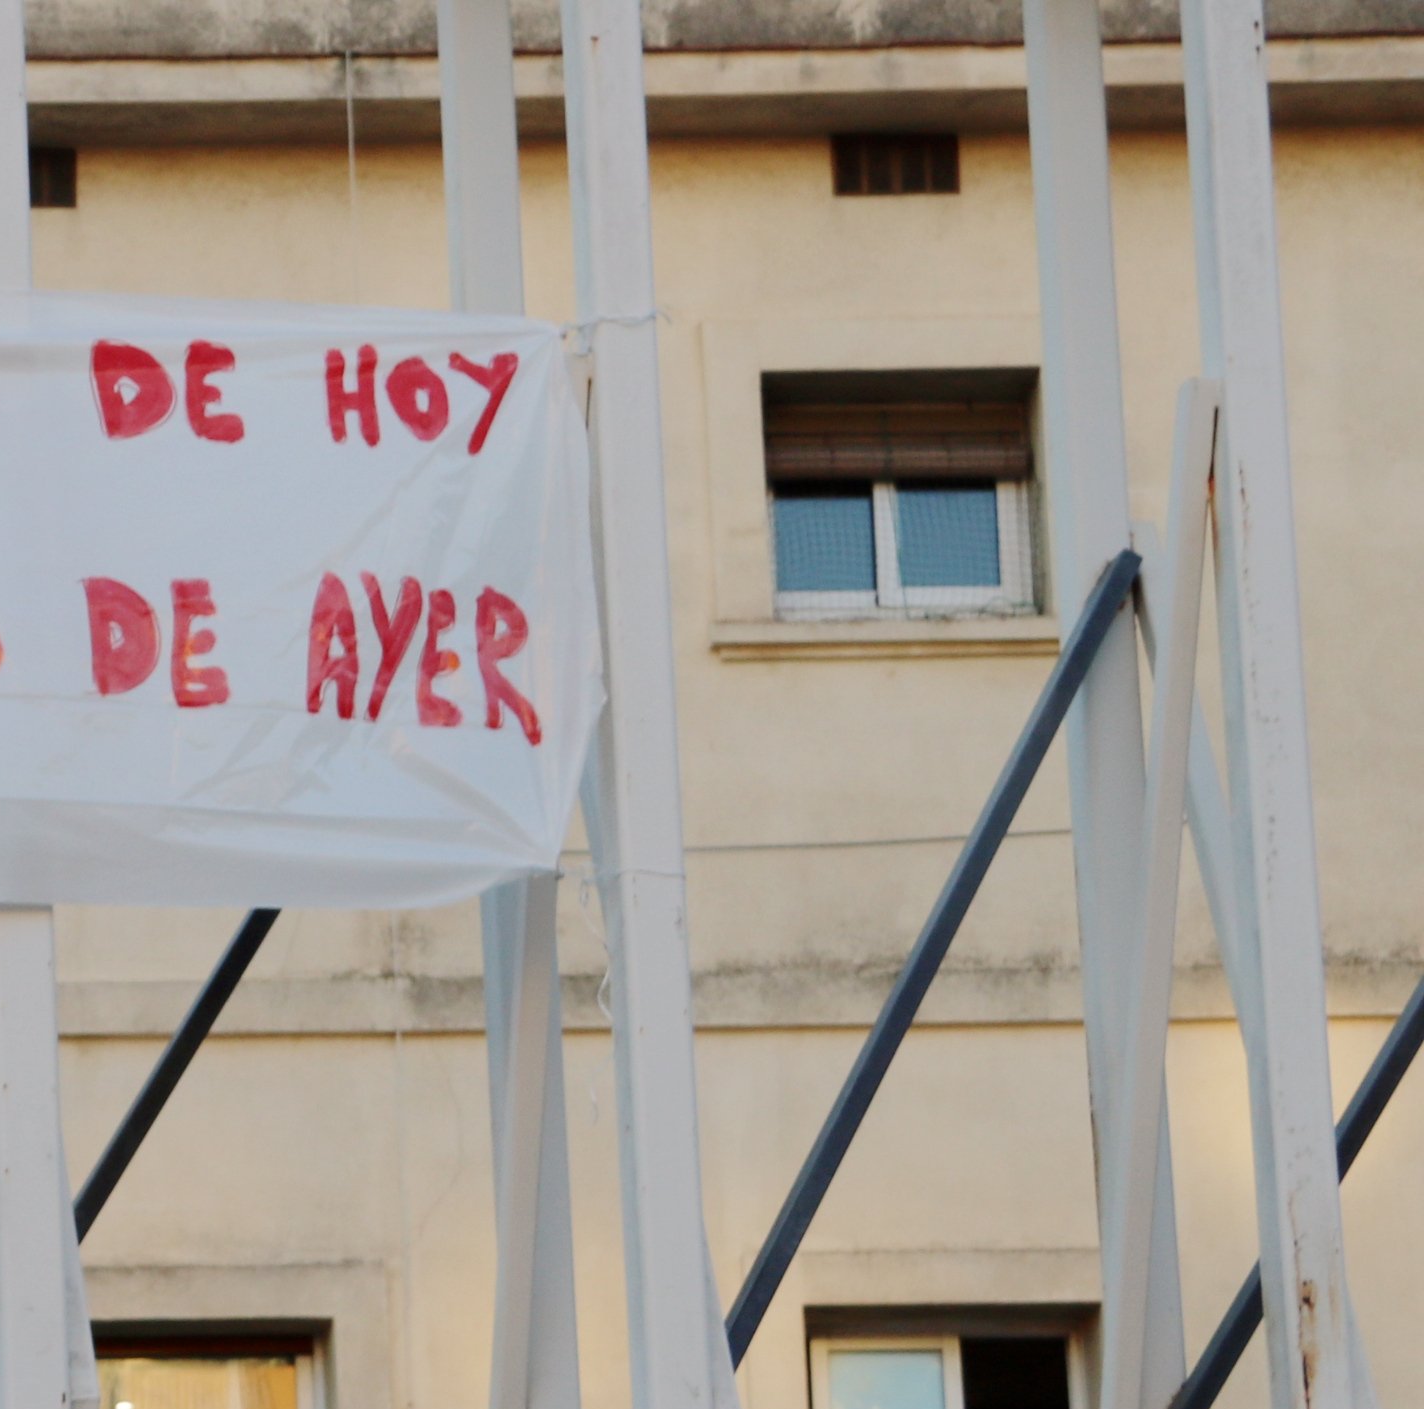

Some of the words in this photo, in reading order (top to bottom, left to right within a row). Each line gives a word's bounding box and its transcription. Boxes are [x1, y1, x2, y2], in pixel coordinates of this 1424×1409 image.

[88, 339, 246, 445] DE
[322, 342, 521, 457] HOY
[82, 575, 231, 710] DE
[304, 571, 544, 748] AYER
